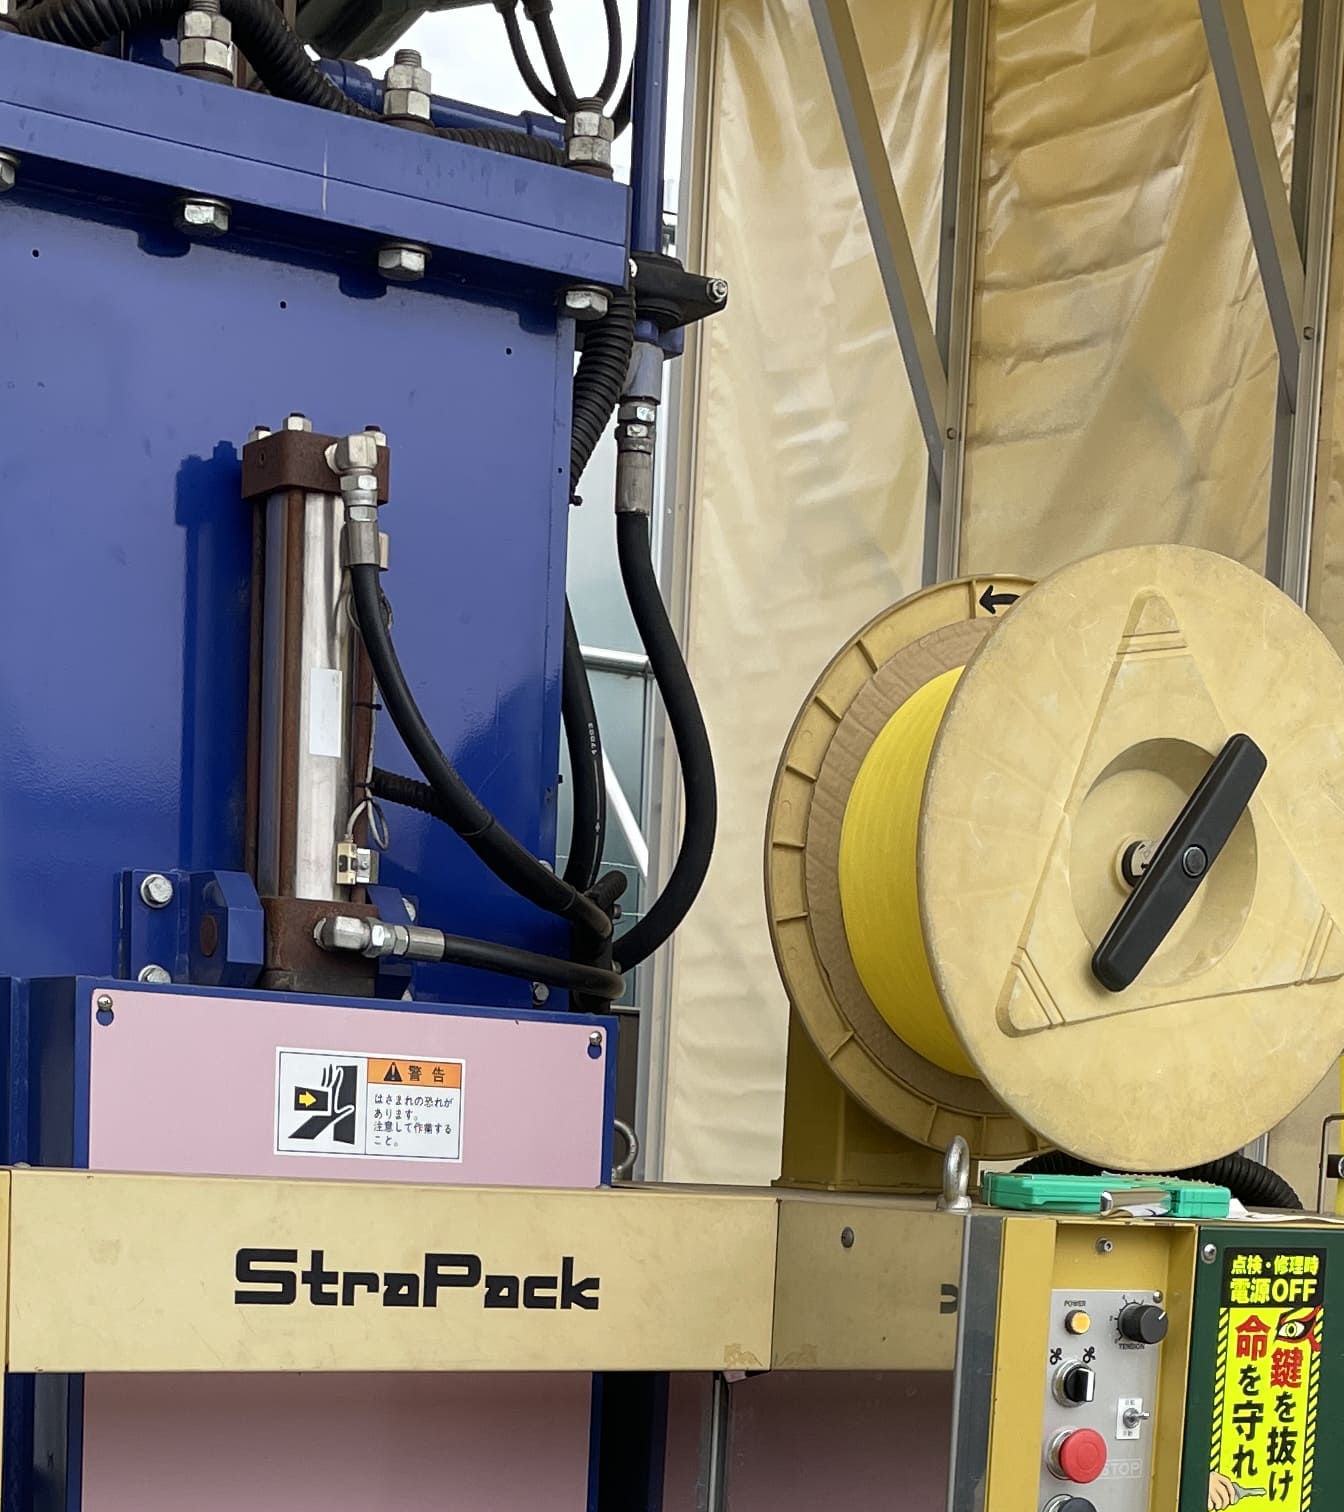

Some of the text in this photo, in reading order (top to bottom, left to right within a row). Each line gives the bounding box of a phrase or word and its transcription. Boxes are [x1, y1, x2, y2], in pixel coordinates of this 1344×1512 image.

[408, 1065, 445, 1083] 警告
[374, 1093, 454, 1108] はさまれの恐れが
[374, 1108, 418, 1121] あります。
[374, 1135, 399, 1147] こと。
[1231, 1254, 1319, 1276] 点検・修理時
[234, 1247, 601, 1310] StraPack
[1230, 1277, 1318, 1304] 電源OFF
[1232, 1315, 1271, 1479] 命を守れ
[1267, 1347, 1304, 1502] 鍵を抜け
